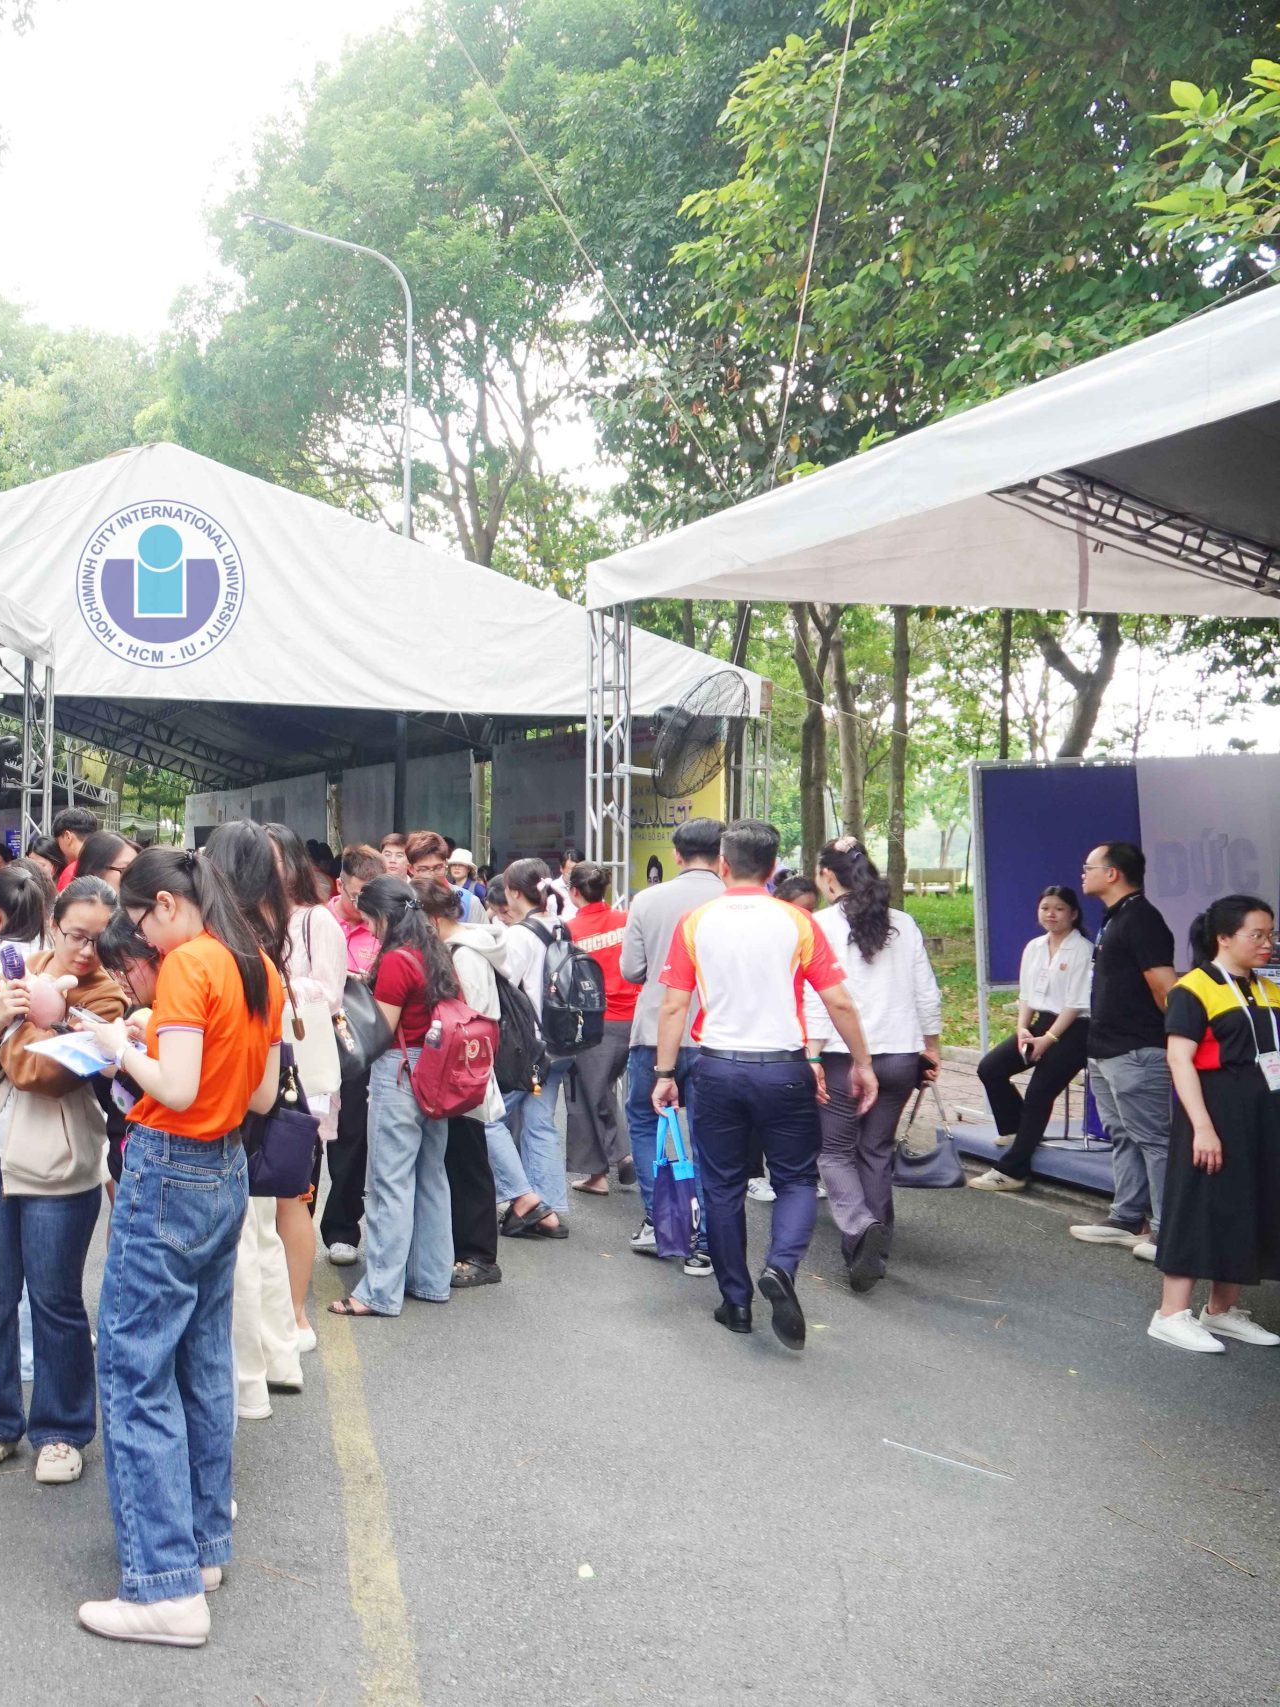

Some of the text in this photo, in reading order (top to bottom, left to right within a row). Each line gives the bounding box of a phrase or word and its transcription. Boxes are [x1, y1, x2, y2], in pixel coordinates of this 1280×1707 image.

[82, 506, 239, 643] HOCHIMINH CITY INTERNATIONAL UNIVERSITY
[126, 644, 164, 663] HCM
[180, 643, 197, 659] IU
